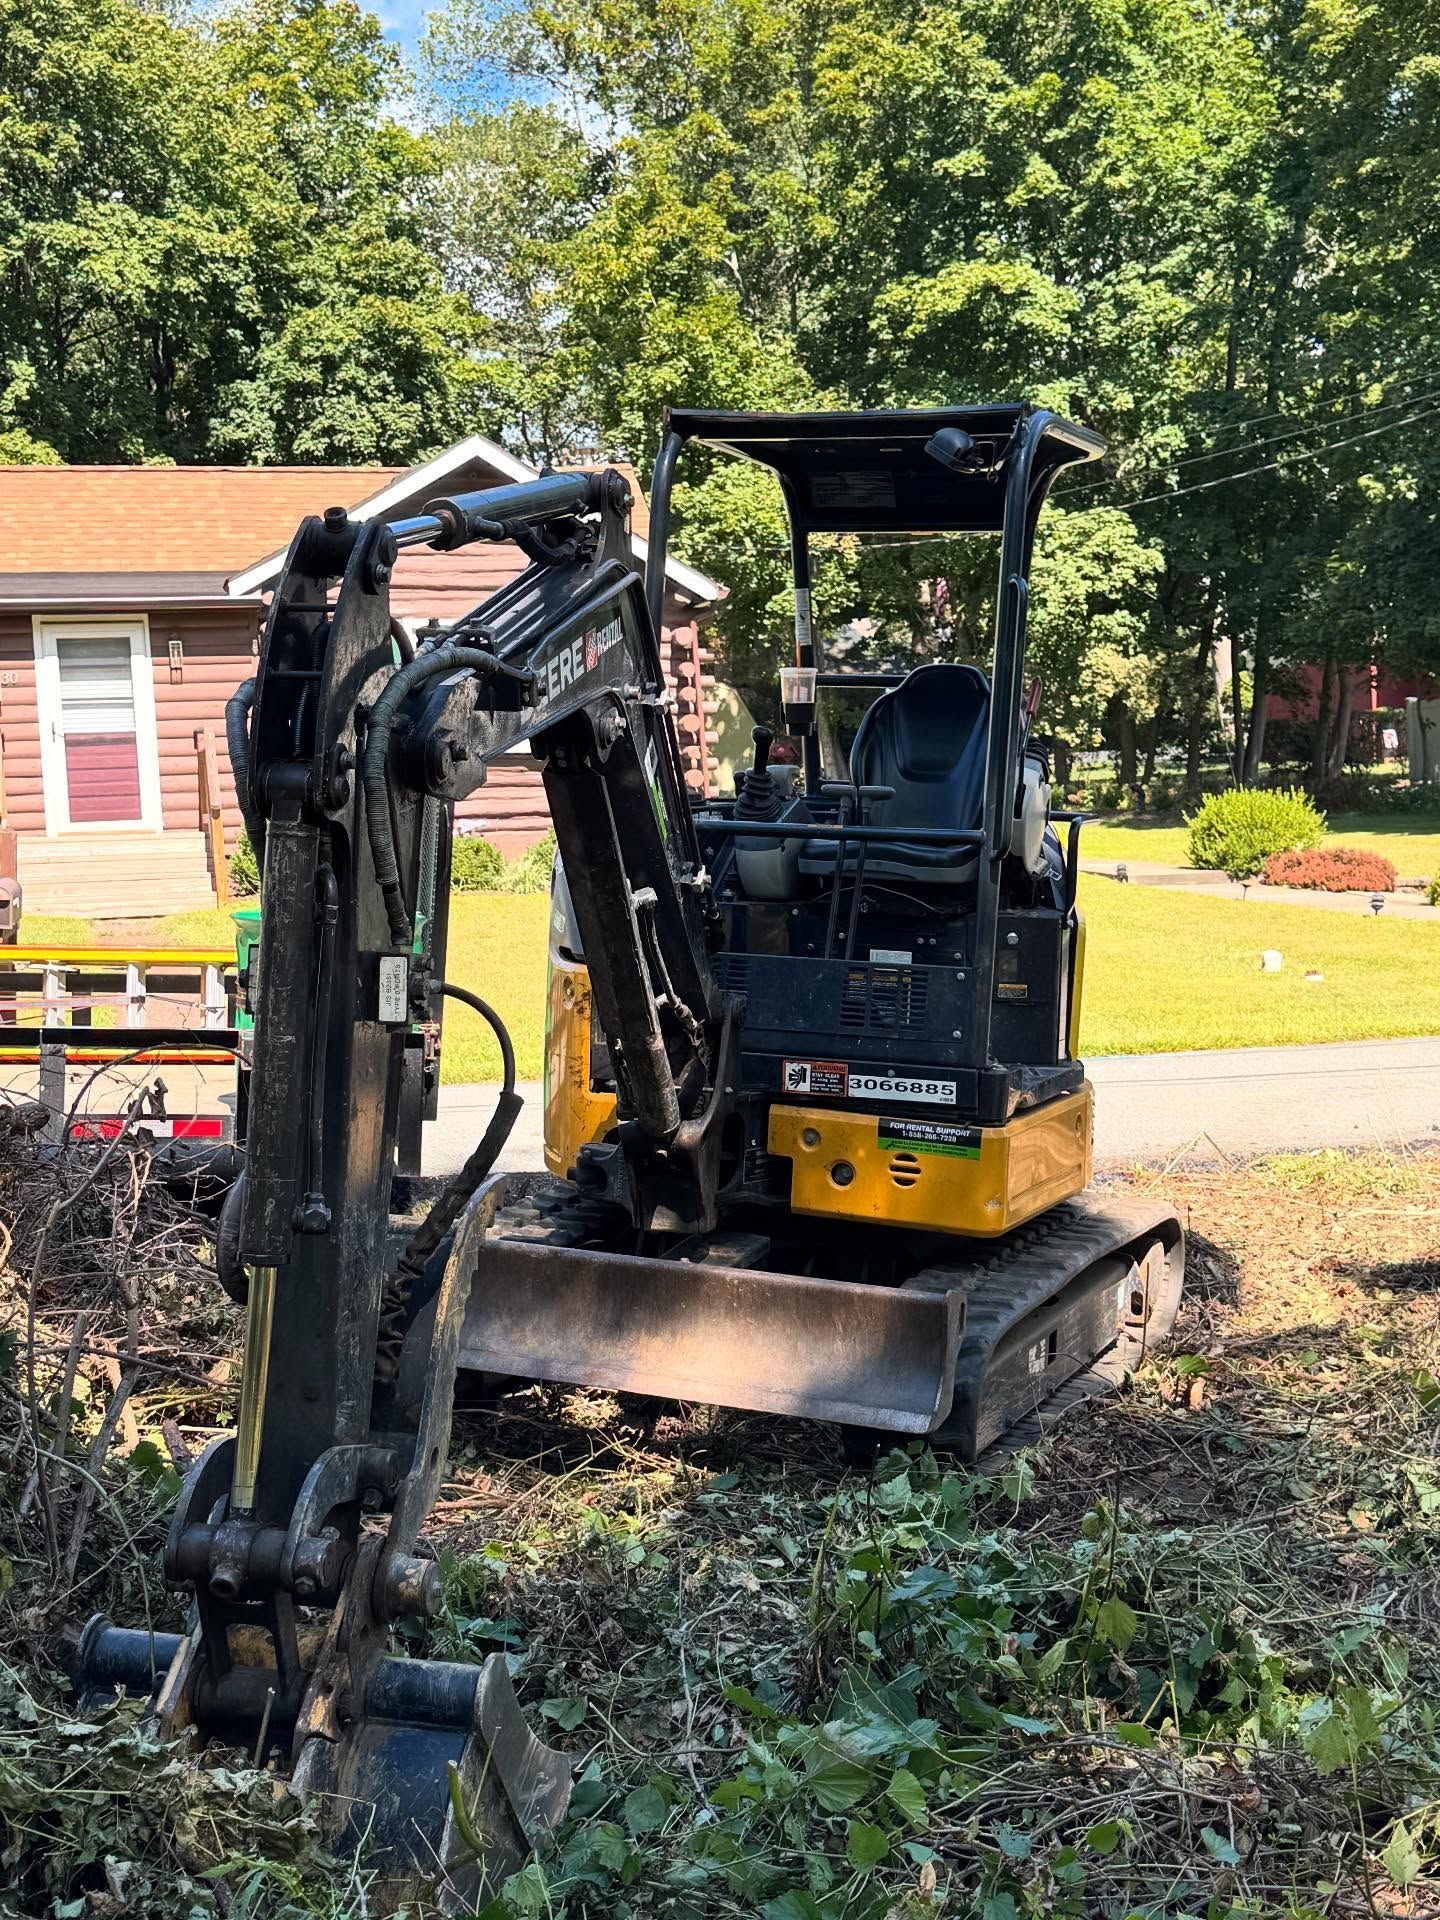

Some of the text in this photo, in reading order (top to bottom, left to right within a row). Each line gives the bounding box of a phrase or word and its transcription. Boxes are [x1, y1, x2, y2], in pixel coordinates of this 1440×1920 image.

[597, 616, 624, 656] RENTAL
[533, 636, 585, 709] ERE
[849, 1078, 954, 1096] 3066885
[889, 1122, 971, 1137] FOR RENTAL SUPPORT
